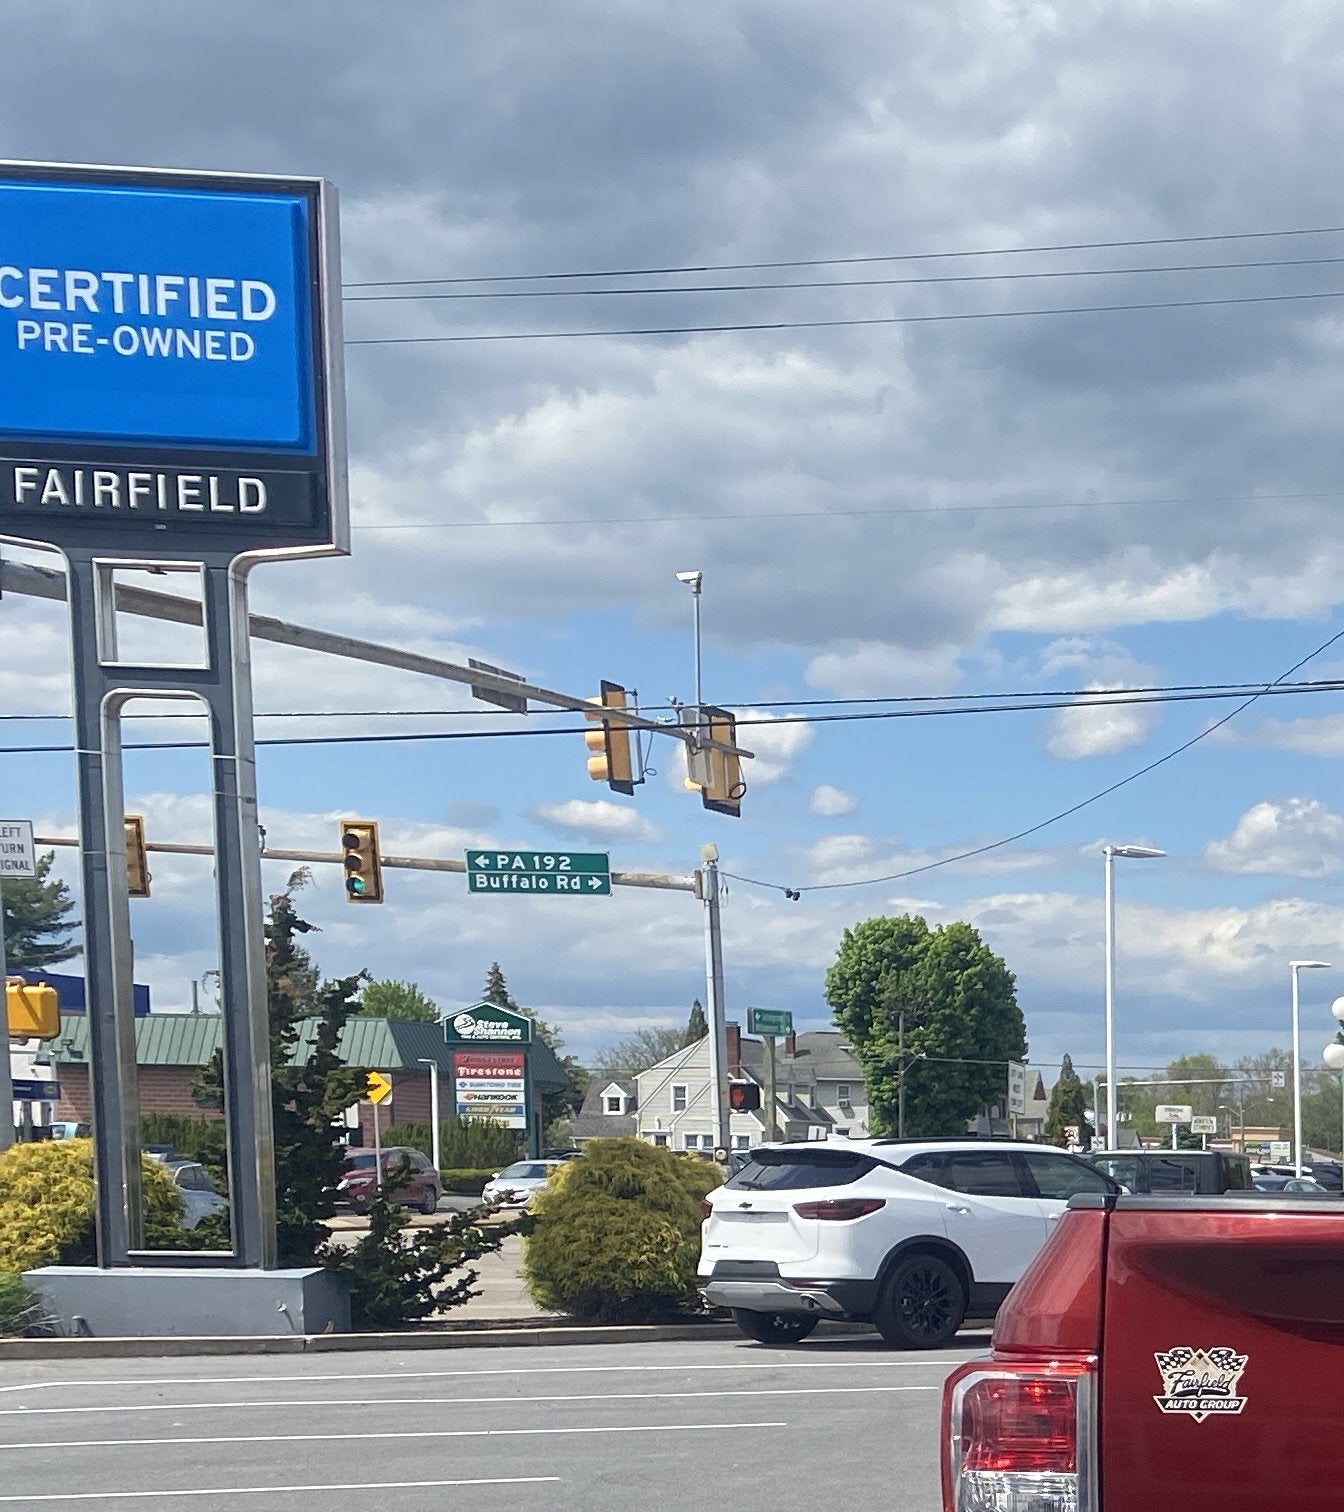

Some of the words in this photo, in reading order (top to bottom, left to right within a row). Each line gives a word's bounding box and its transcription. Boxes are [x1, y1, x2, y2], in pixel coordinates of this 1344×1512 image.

[0, 265, 276, 321] CERTIFIED
[17, 319, 255, 361] PRE-OWNED
[14, 467, 268, 513] FAIRFIELD
[0, 860, 31, 871] IGNAL
[496, 854, 526, 870] PA
[533, 855, 572, 870] 192
[475, 873, 549, 889] Buffalo
[556, 875, 581, 890] Rd
[473, 1027, 522, 1036] Shannon
[476, 1019, 509, 1029] Steve
[457, 1066, 521, 1076] Firestone
[1167, 1369, 1236, 1395] Fairfield
[1164, 1399, 1198, 1409] AUTO
[1199, 1400, 1240, 1410] GROUP
